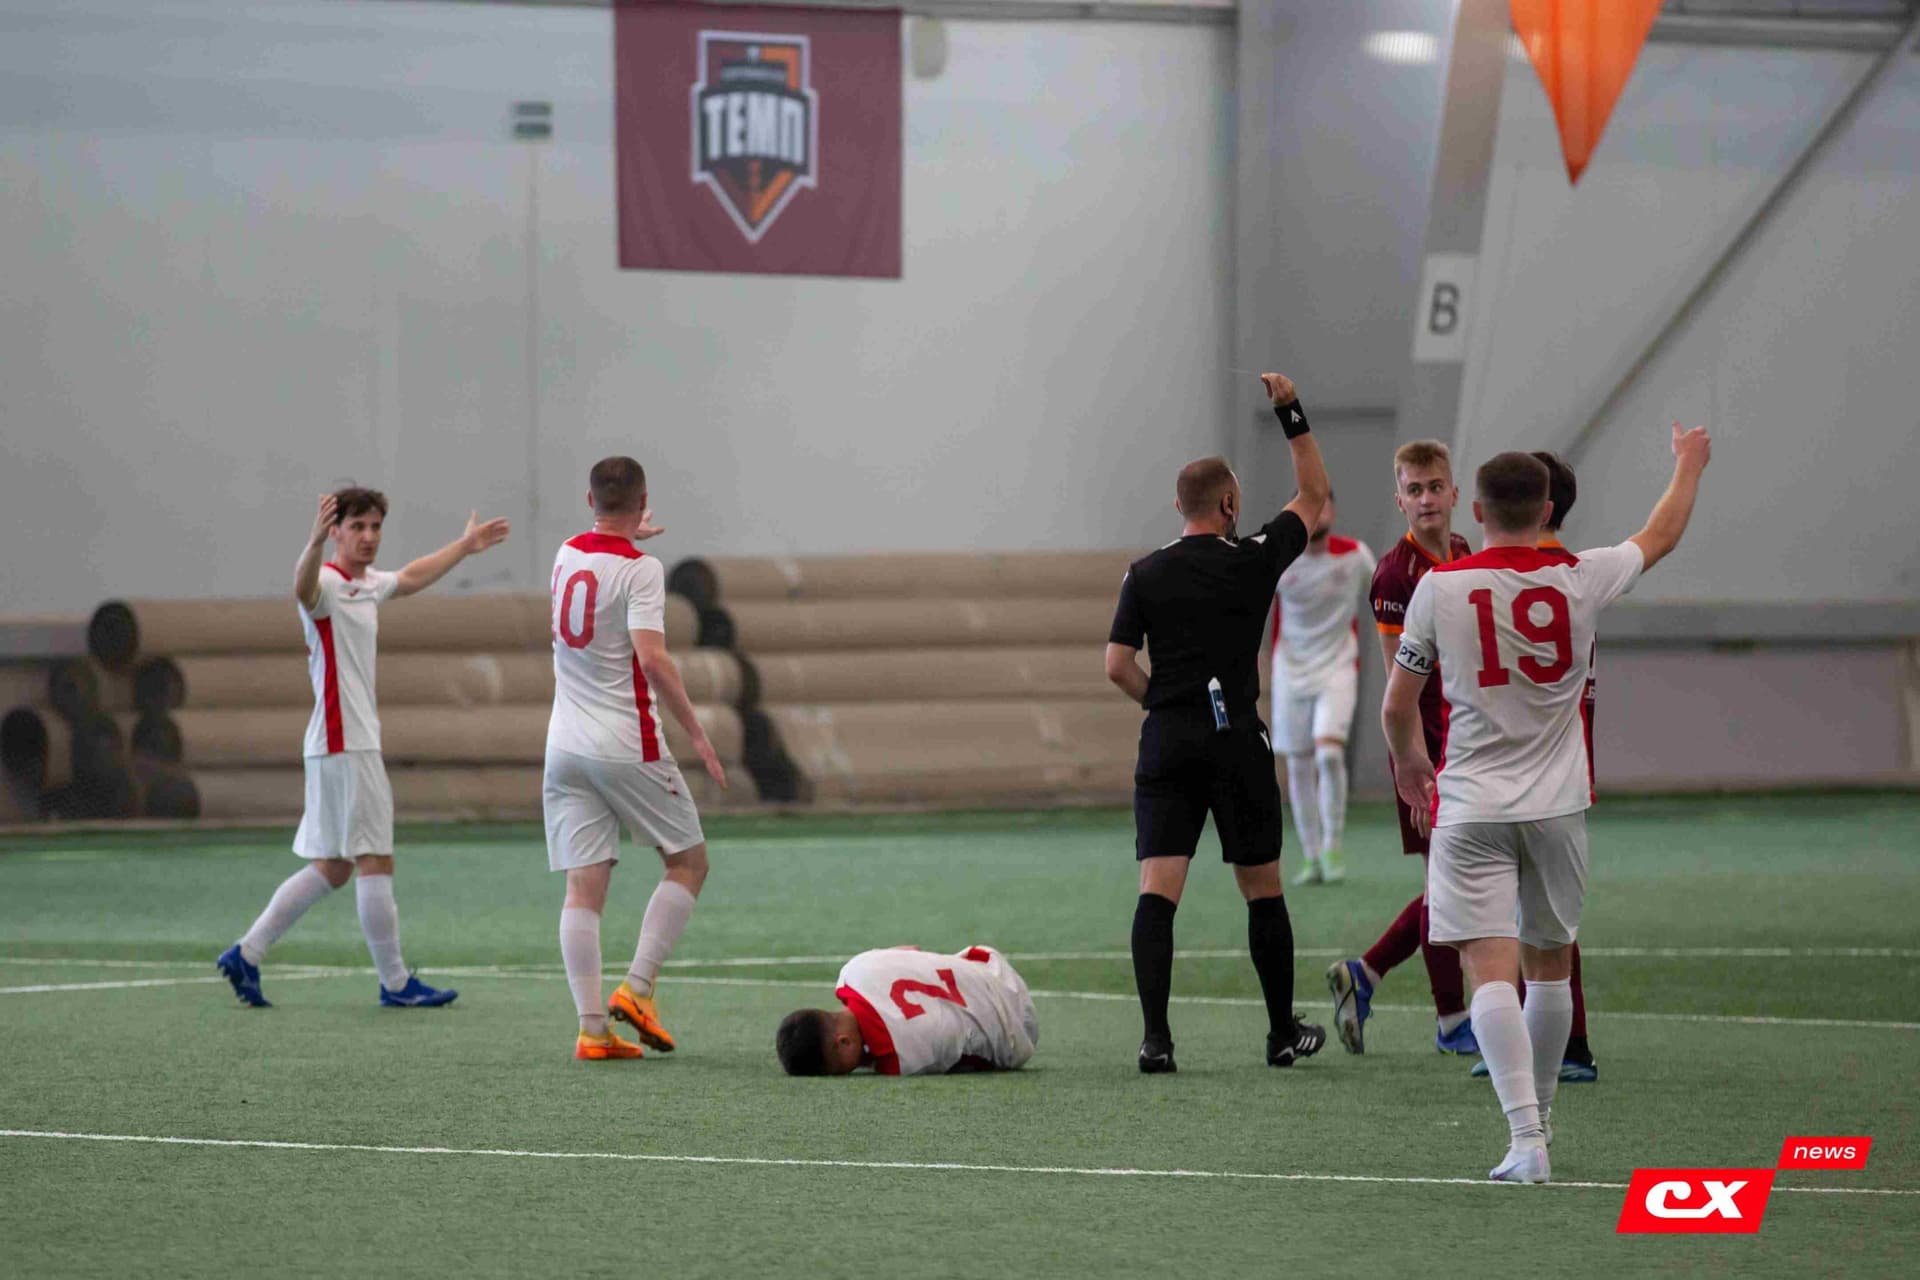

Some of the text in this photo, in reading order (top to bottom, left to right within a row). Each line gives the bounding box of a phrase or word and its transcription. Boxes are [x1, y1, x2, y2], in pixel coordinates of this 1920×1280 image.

[703, 90, 806, 166] ТЕМП
[552, 565, 599, 649] 0
[1468, 585, 1574, 688] 19
[889, 968, 968, 1021] 2
